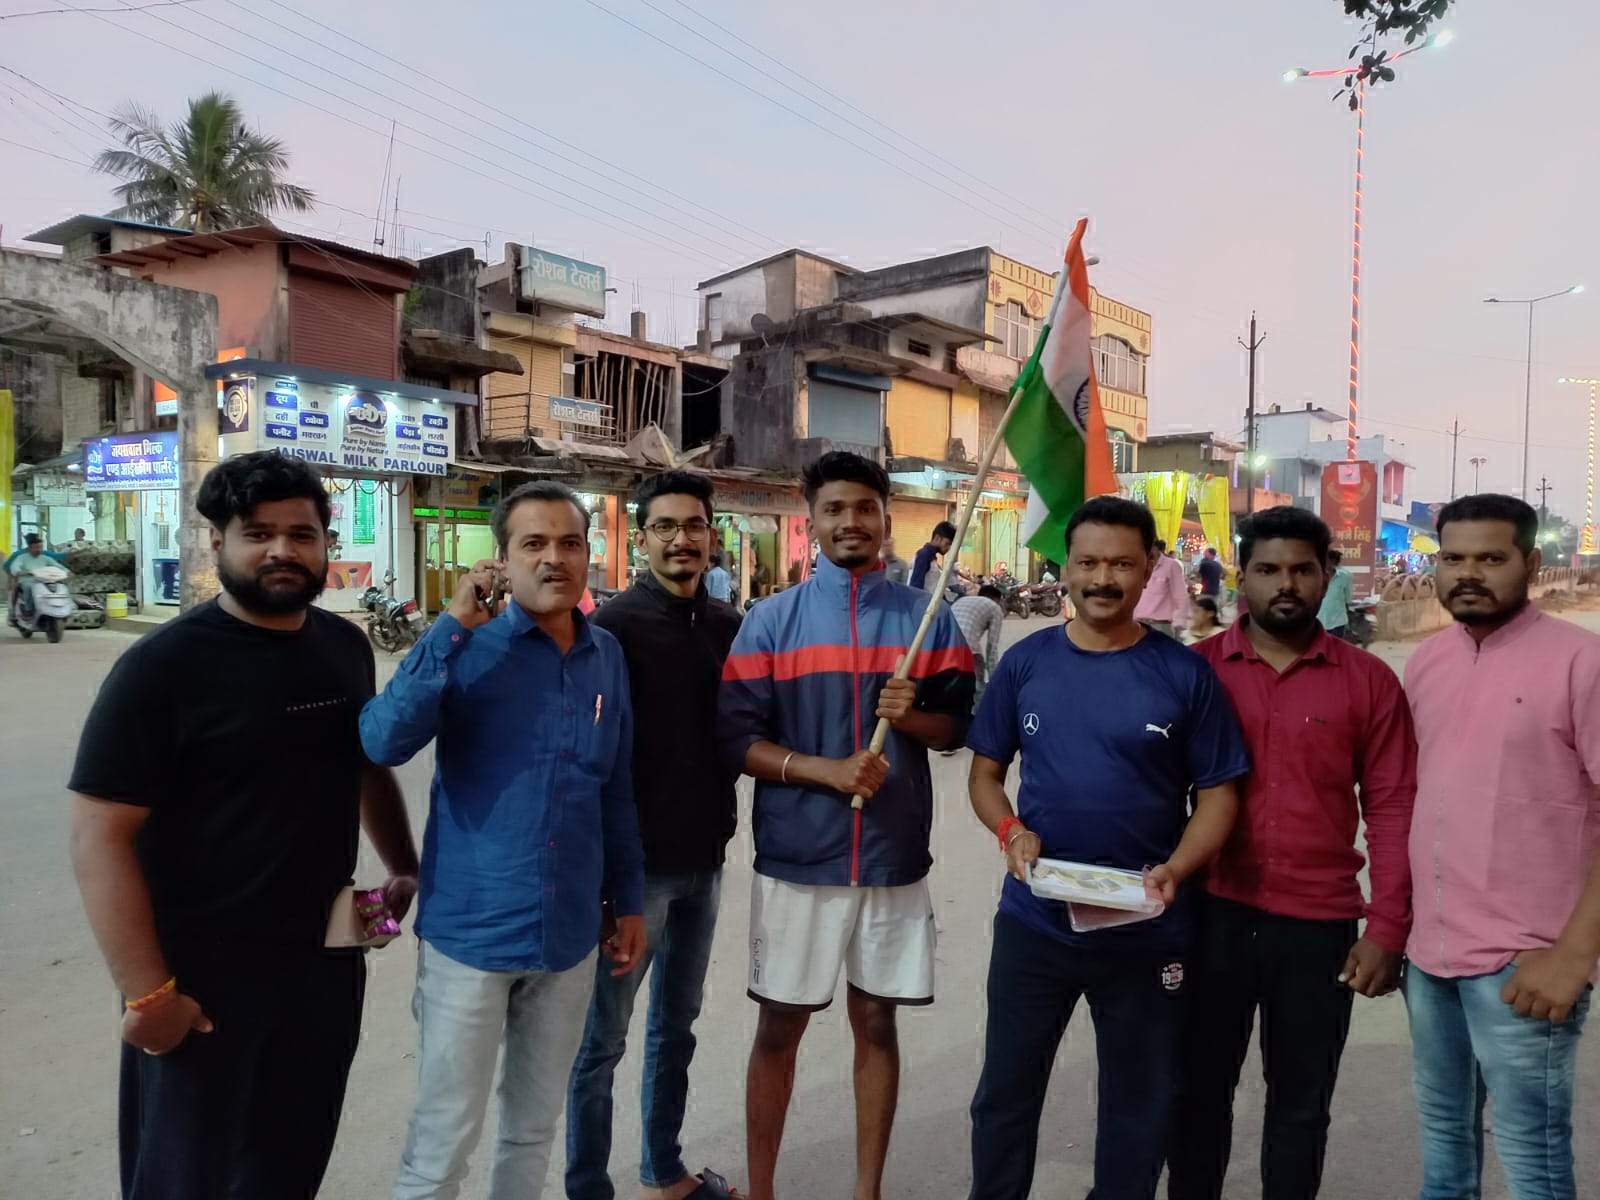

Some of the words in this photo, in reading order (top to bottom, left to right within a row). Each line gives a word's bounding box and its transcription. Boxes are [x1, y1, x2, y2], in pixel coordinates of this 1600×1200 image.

[532, 254, 567, 283] रोशन
[570, 262, 600, 293] टेलर्स
[343, 453, 377, 468] MILK
[384, 458, 444, 475] PARLOUR
